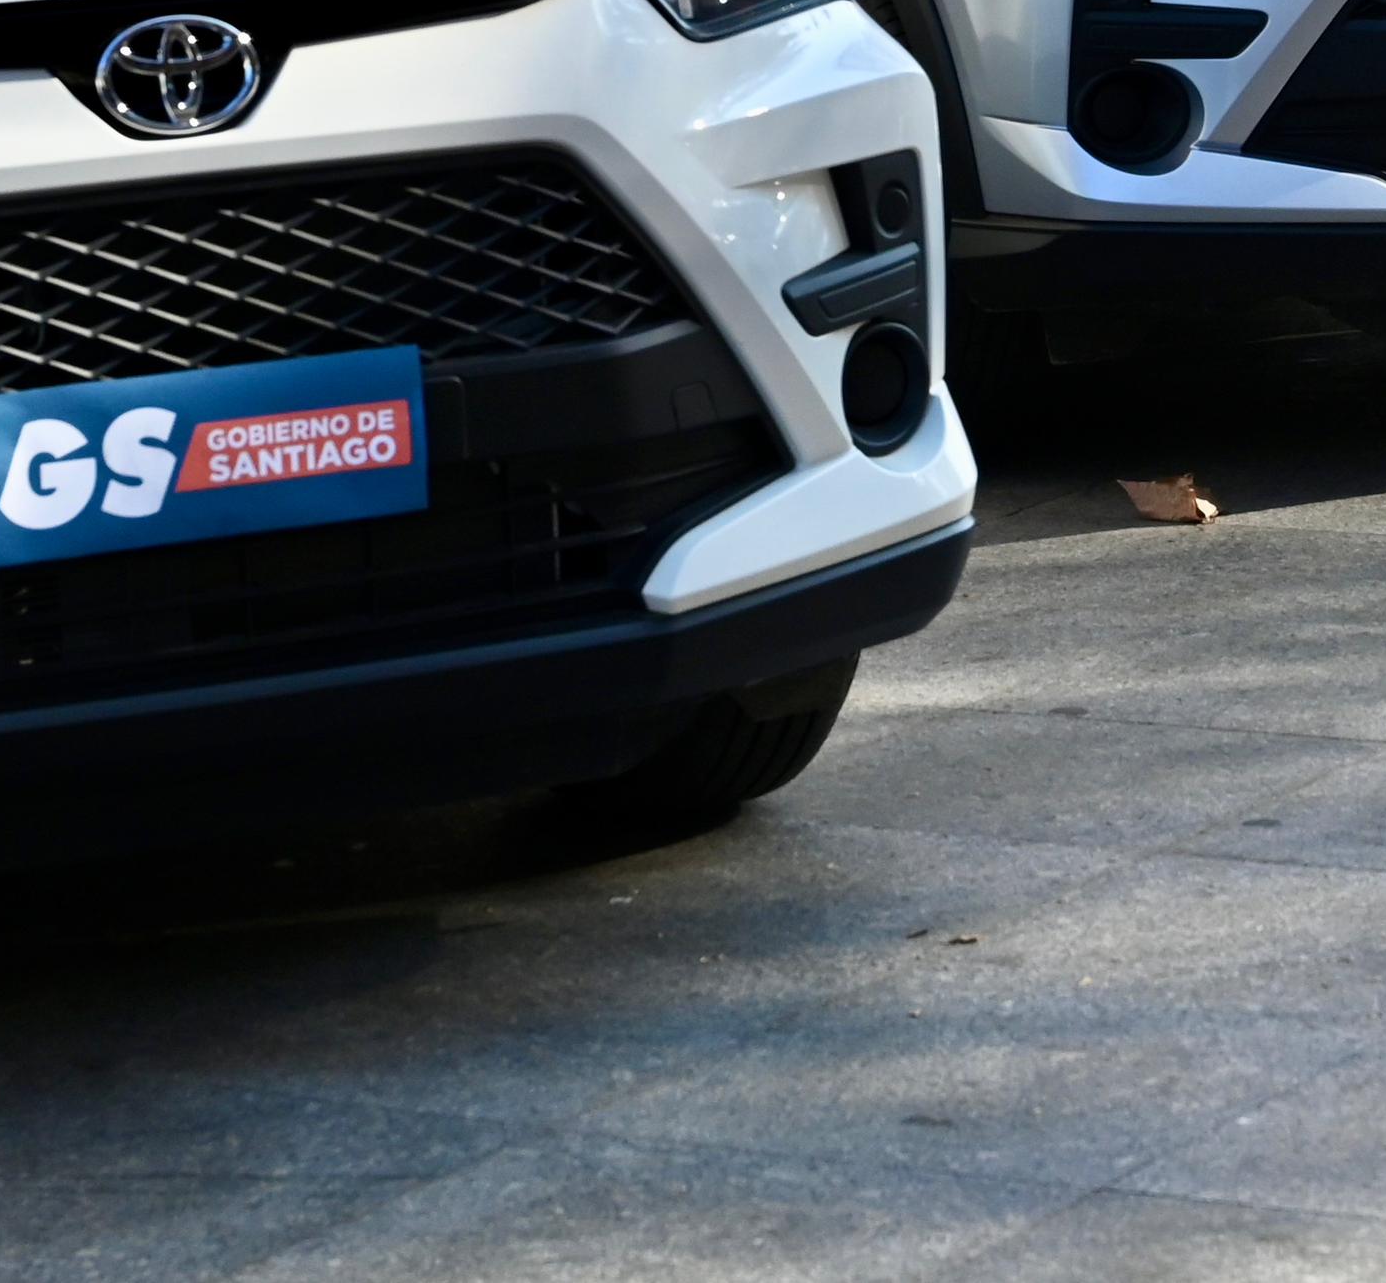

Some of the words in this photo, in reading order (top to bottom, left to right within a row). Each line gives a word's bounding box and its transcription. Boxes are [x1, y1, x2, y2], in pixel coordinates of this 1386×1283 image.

[207, 413, 350, 452] GOBIERNO
[357, 409, 395, 431] DE
[209, 435, 397, 483] SANTIAGO
